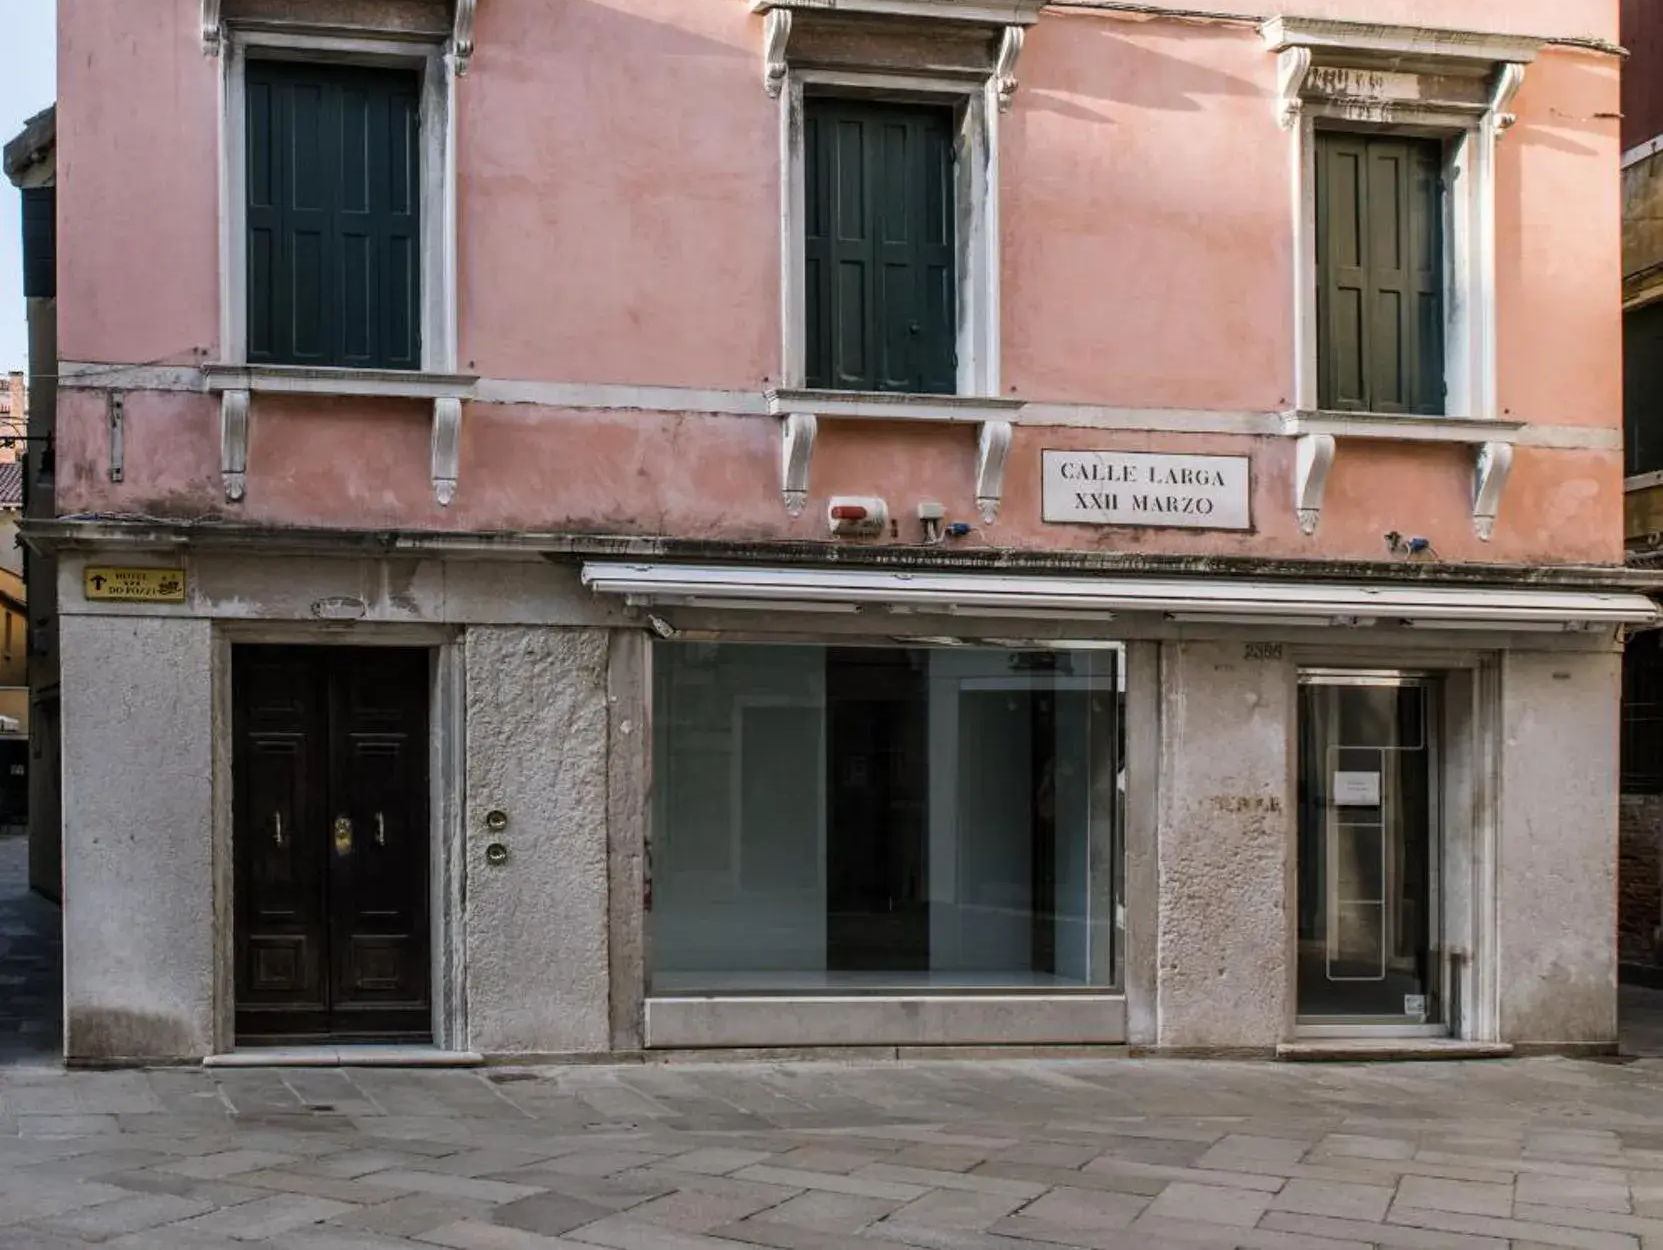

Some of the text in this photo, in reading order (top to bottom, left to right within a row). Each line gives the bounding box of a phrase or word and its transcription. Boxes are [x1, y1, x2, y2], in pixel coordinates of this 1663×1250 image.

[1060, 462, 1225, 487] CALLE LARGA
[1075, 492, 1214, 515] XXII MARZO
